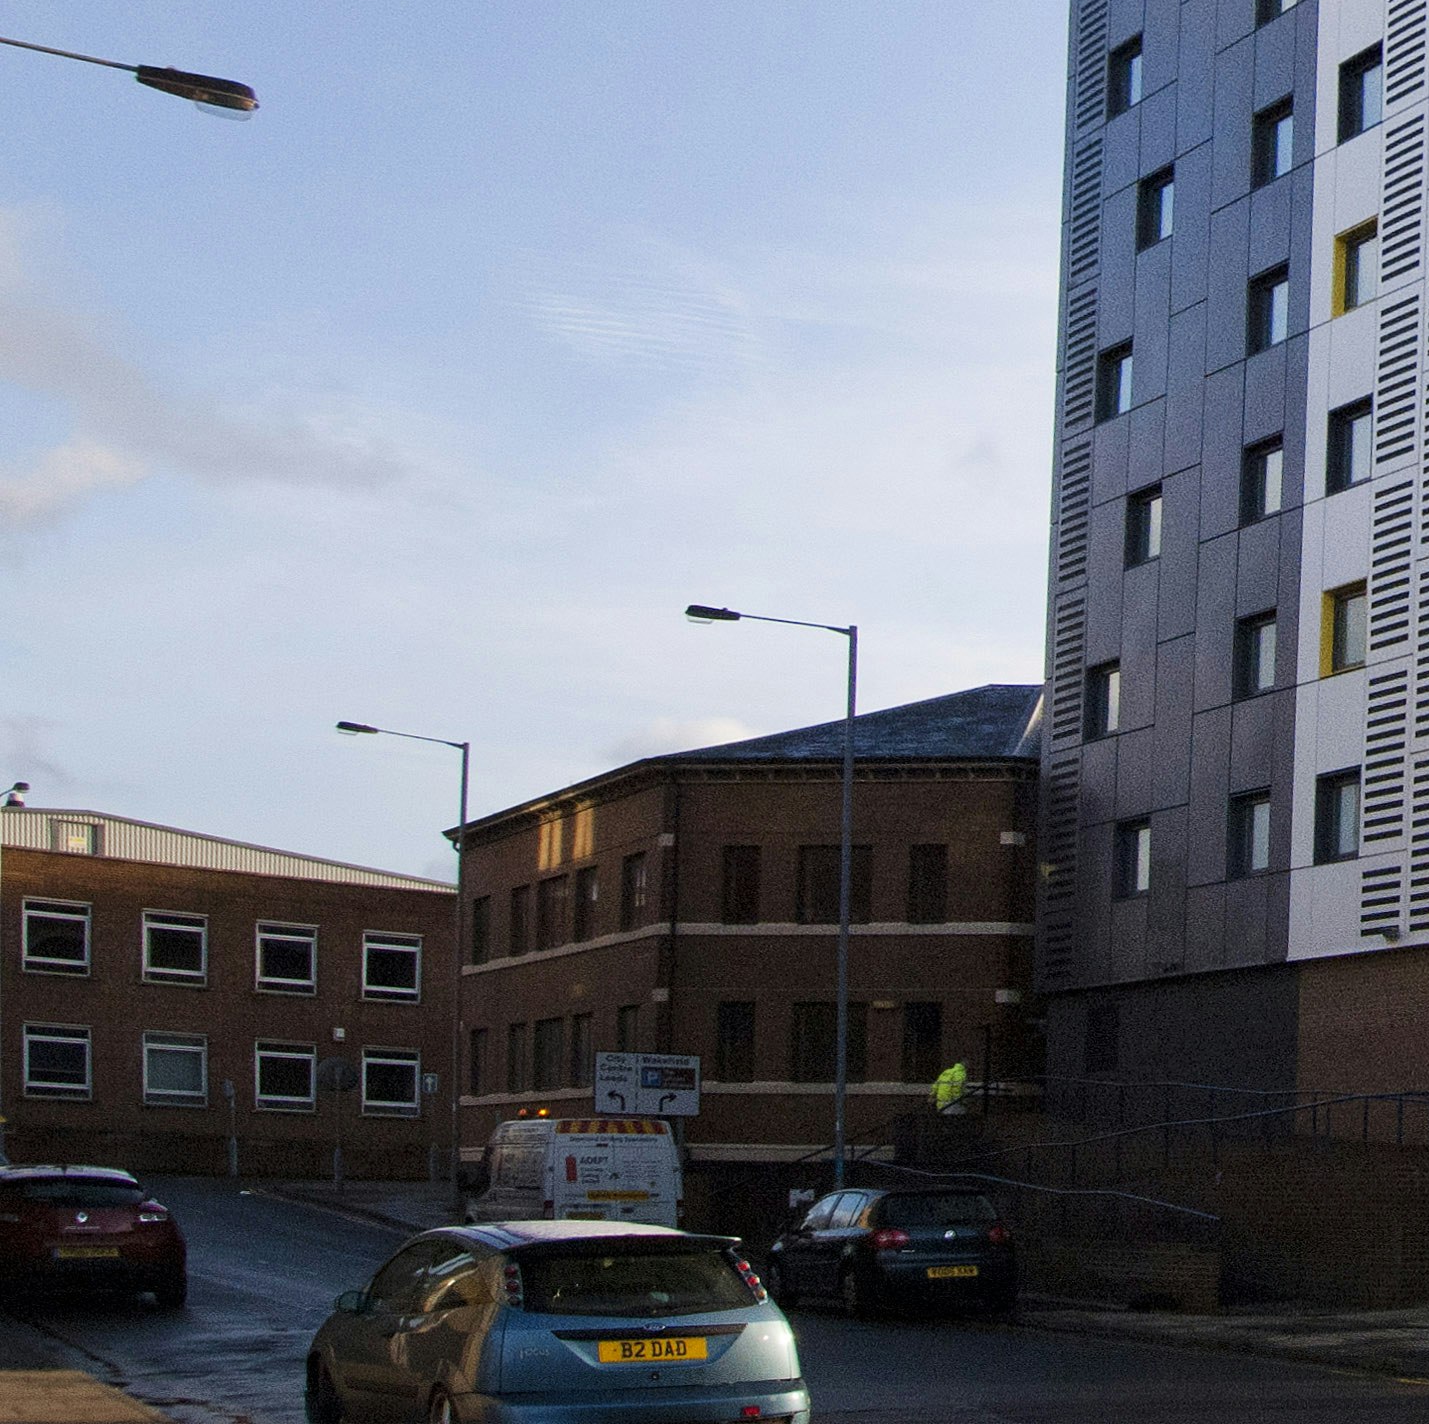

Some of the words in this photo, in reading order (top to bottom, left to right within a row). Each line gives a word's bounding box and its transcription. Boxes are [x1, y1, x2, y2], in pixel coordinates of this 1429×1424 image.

[642, 1056, 690, 1066] Wakefield
[600, 1063, 633, 1072] Centre
[599, 1074, 628, 1083] Leeds
[620, 1342, 646, 1358] B2
[651, 1340, 688, 1358] DAD
